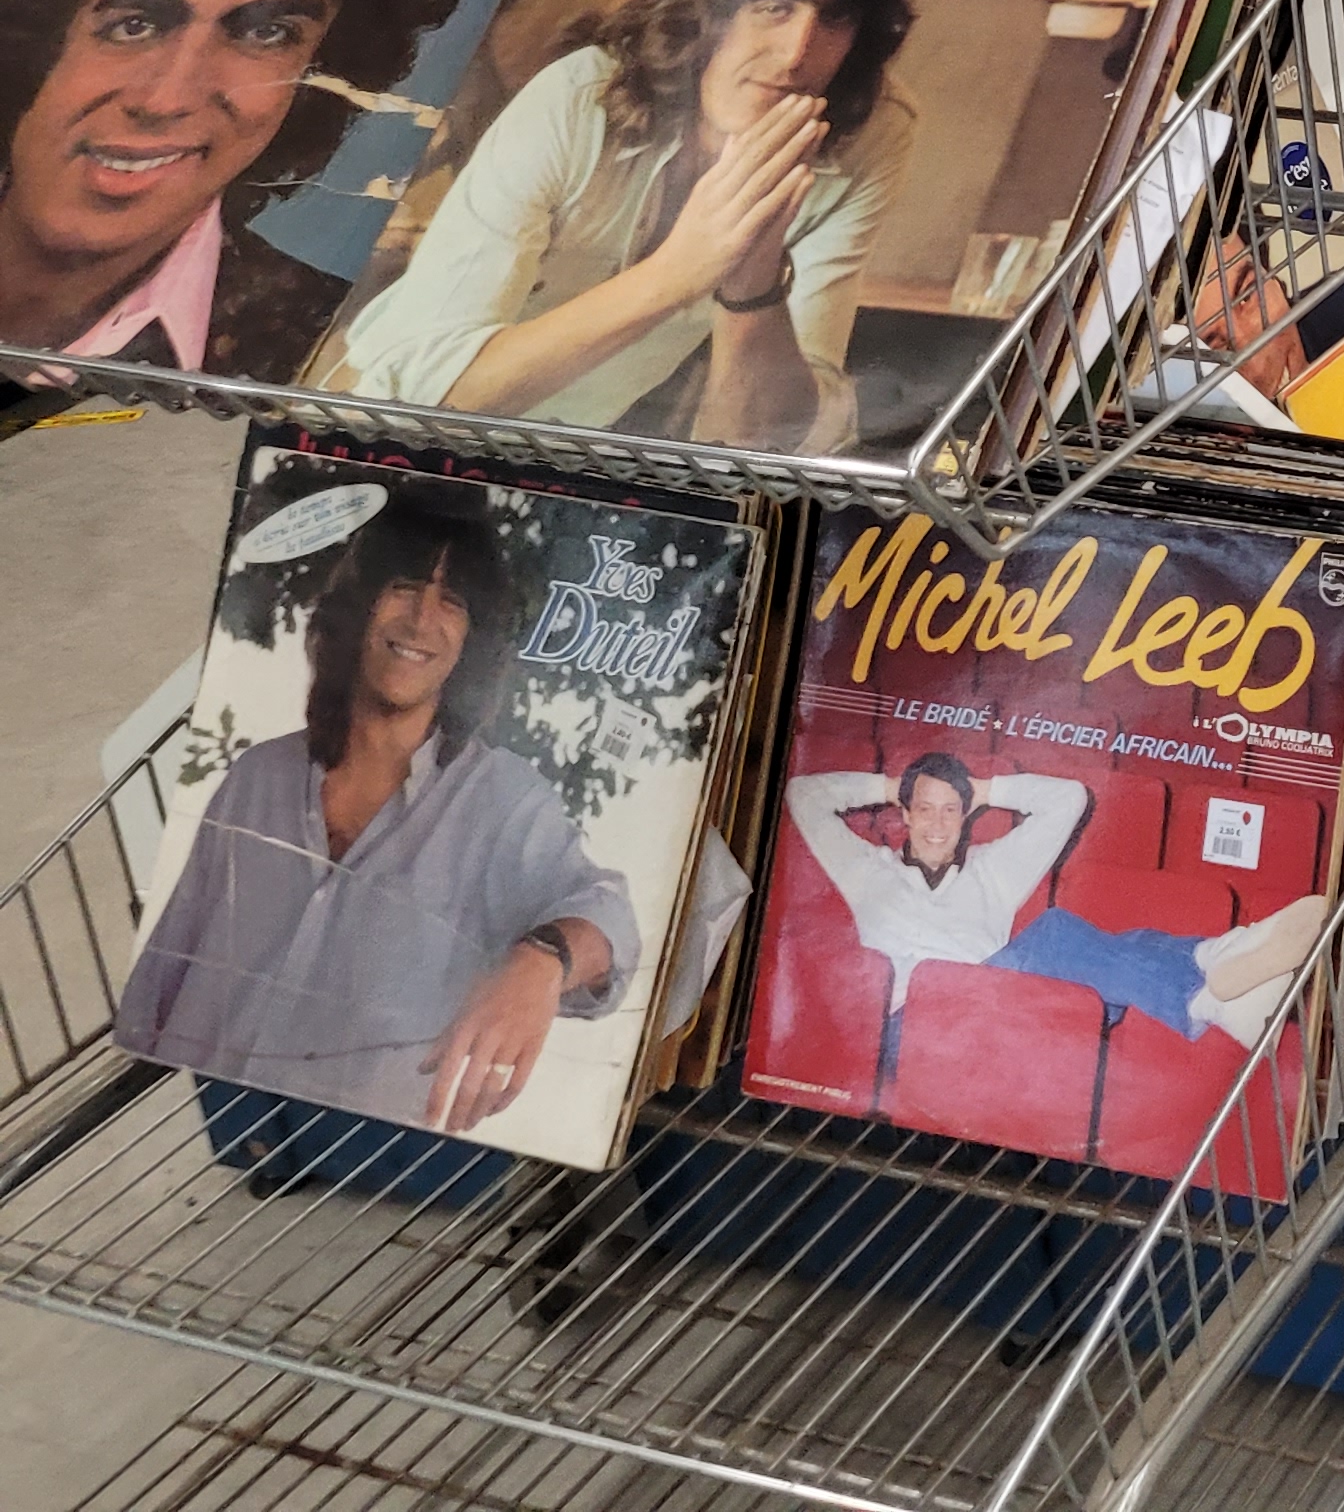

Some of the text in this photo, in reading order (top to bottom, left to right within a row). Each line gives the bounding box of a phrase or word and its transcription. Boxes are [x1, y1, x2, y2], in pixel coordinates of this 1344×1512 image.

[587, 533, 663, 605] Yves
[813, 512, 1316, 712] Michel Leeb
[517, 580, 701, 683] Duteil
[893, 698, 1234, 773] LE BRIDÉ L'ÉPICIER AFRICAIN...
